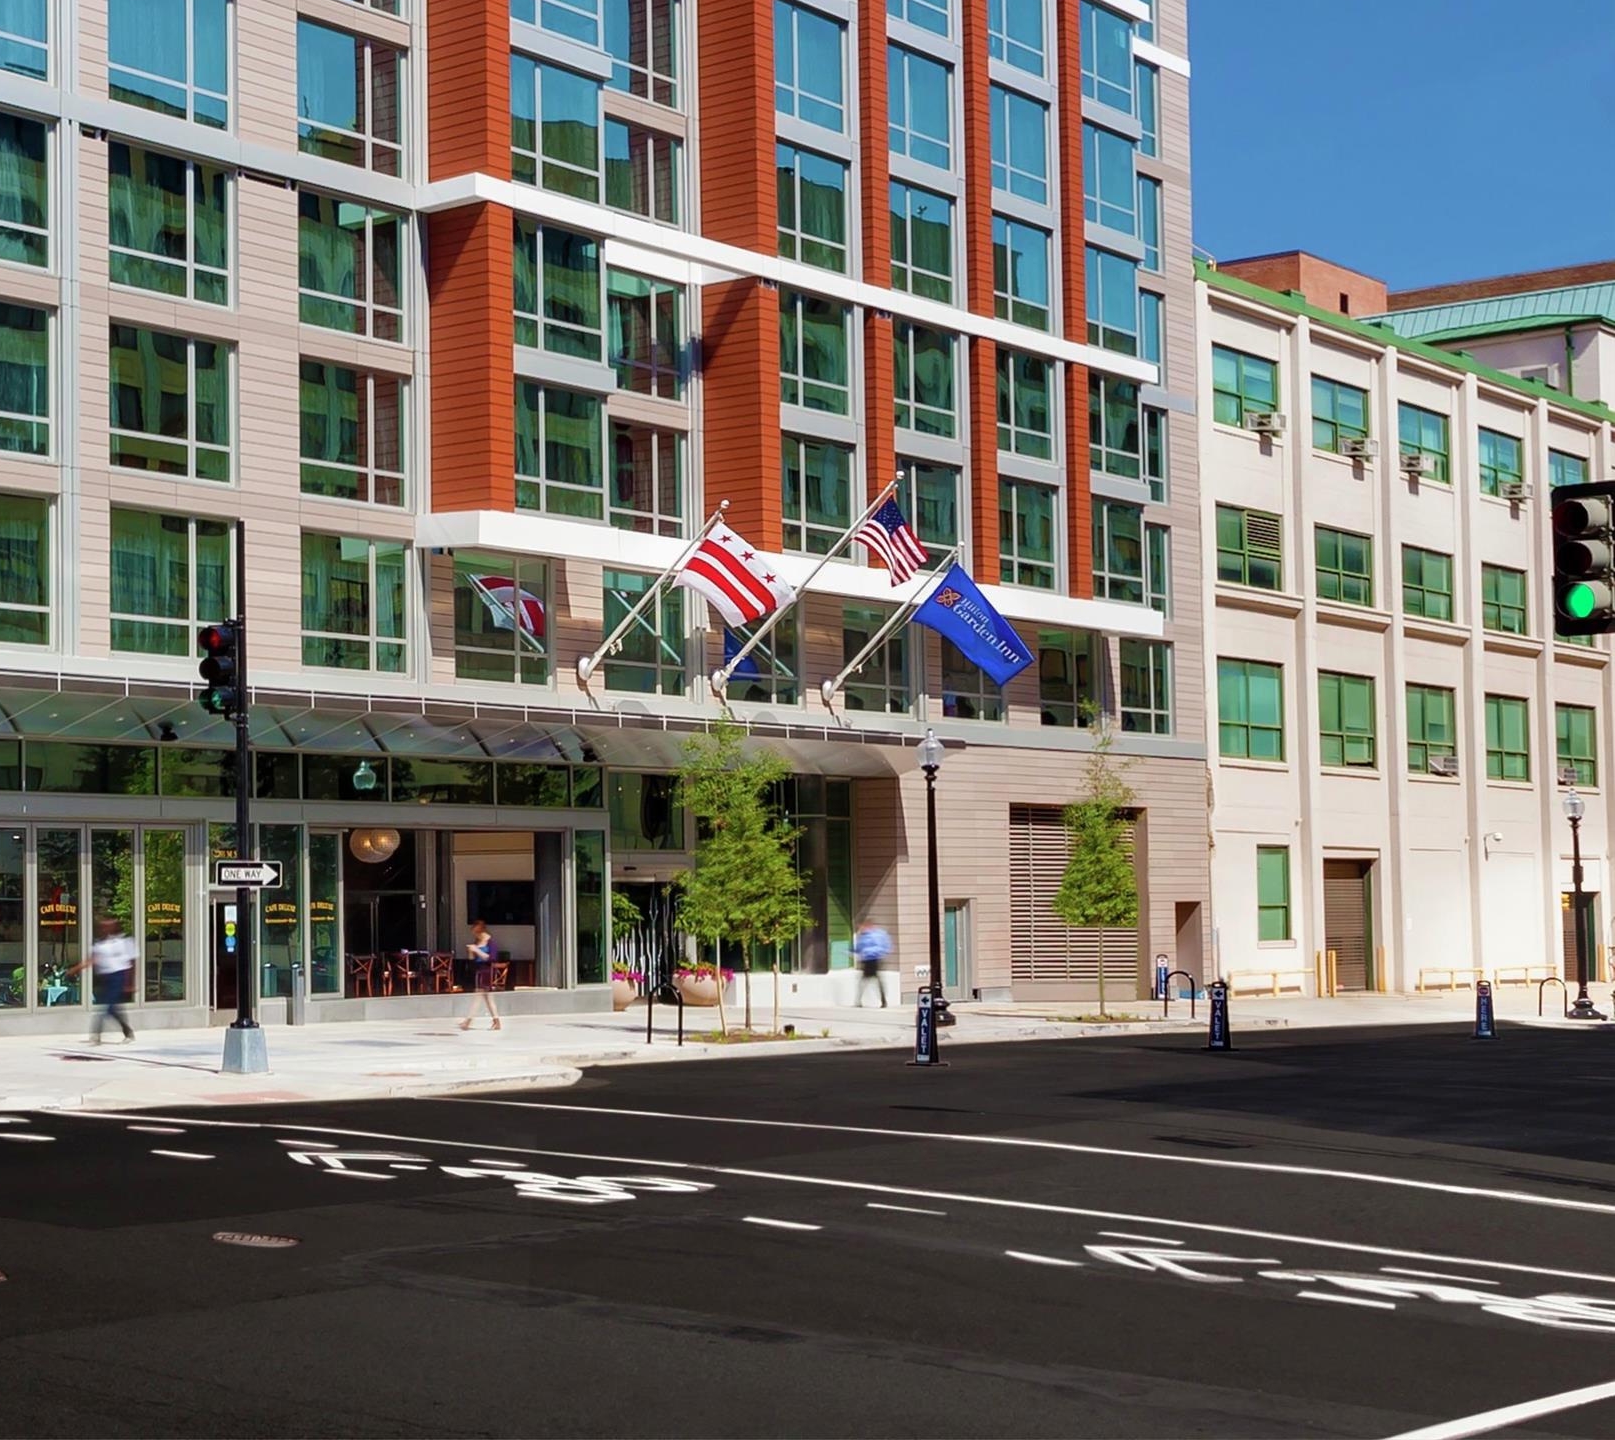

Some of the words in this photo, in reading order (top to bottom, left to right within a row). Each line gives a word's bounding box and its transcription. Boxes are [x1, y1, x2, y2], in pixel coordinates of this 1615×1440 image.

[952, 603, 998, 647] Garden
[995, 640, 1021, 664] Inn
[223, 869, 242, 879] ONE
[244, 869, 262, 879] WAY
[920, 1009, 929, 1053] VALET
[1213, 1001, 1222, 1040] VALET
